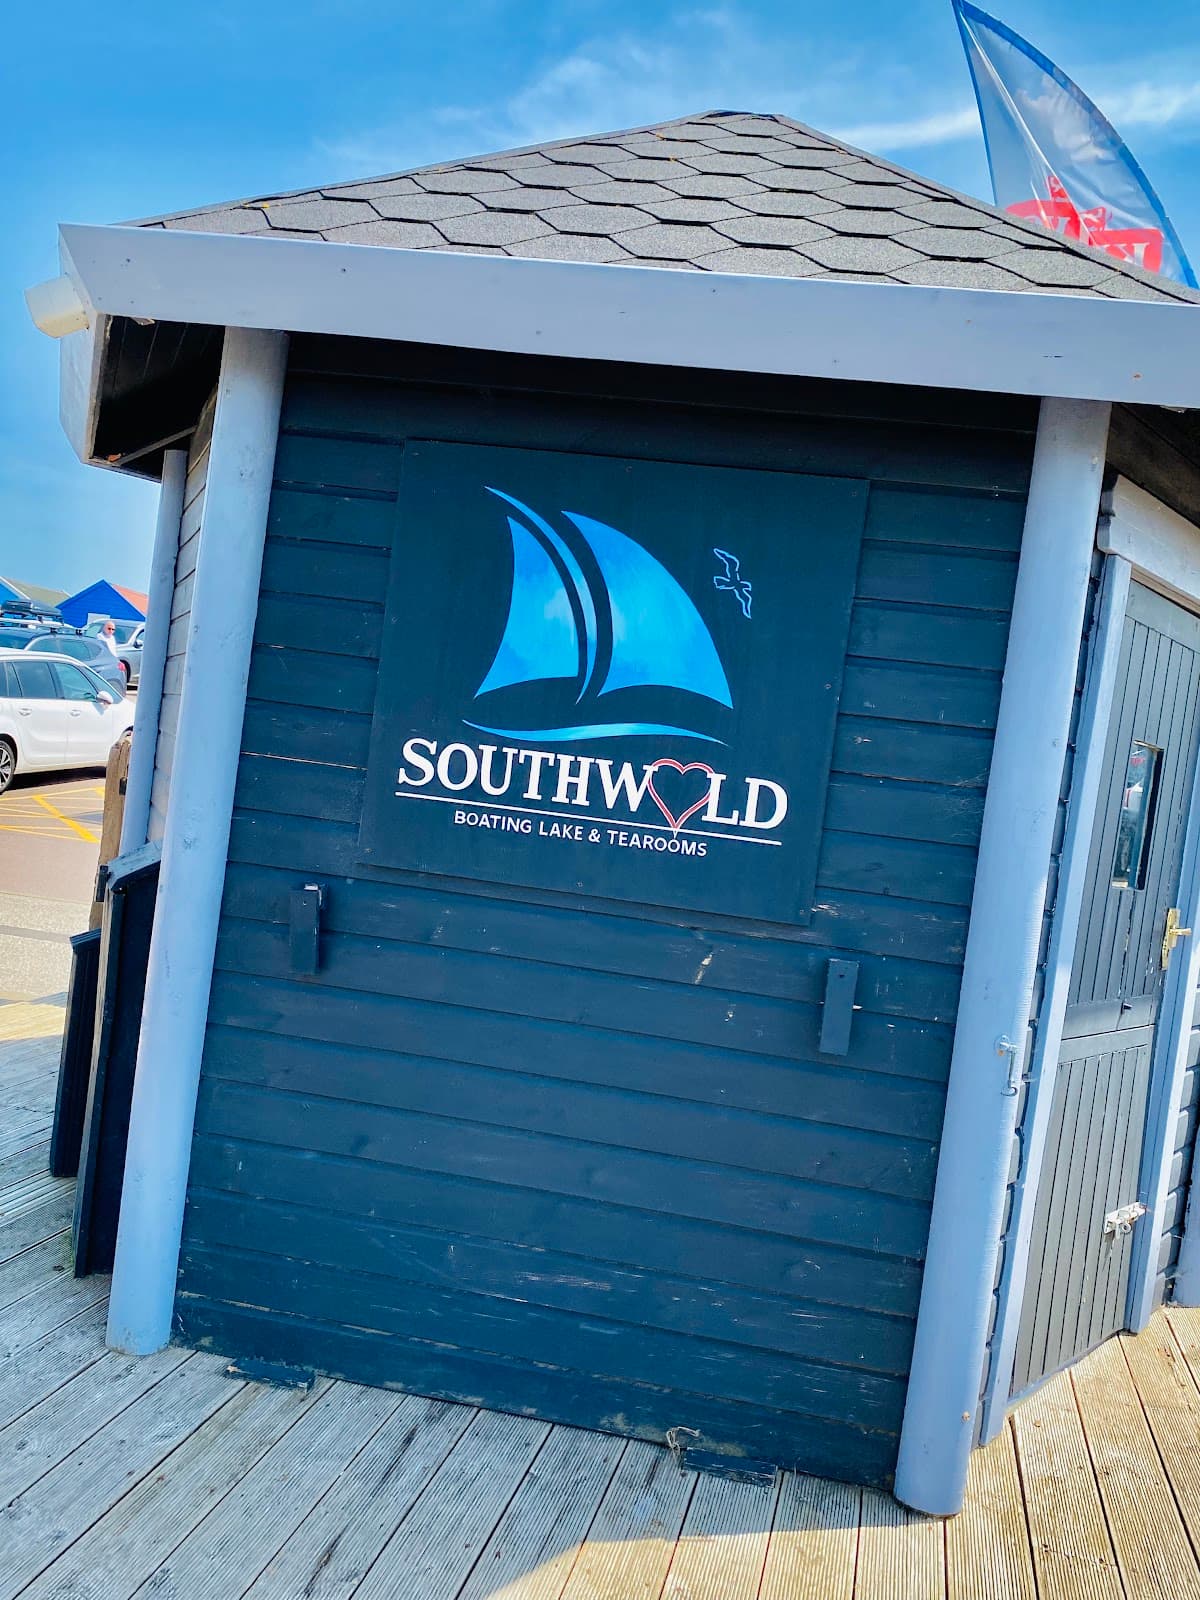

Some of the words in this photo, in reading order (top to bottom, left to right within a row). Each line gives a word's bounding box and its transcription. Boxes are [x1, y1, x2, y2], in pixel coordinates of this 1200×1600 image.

[454, 810, 532, 834] BOATING
[539, 821, 584, 841] LAKE
[588, 828, 601, 843] &
[606, 829, 708, 857] TEAROOMS
